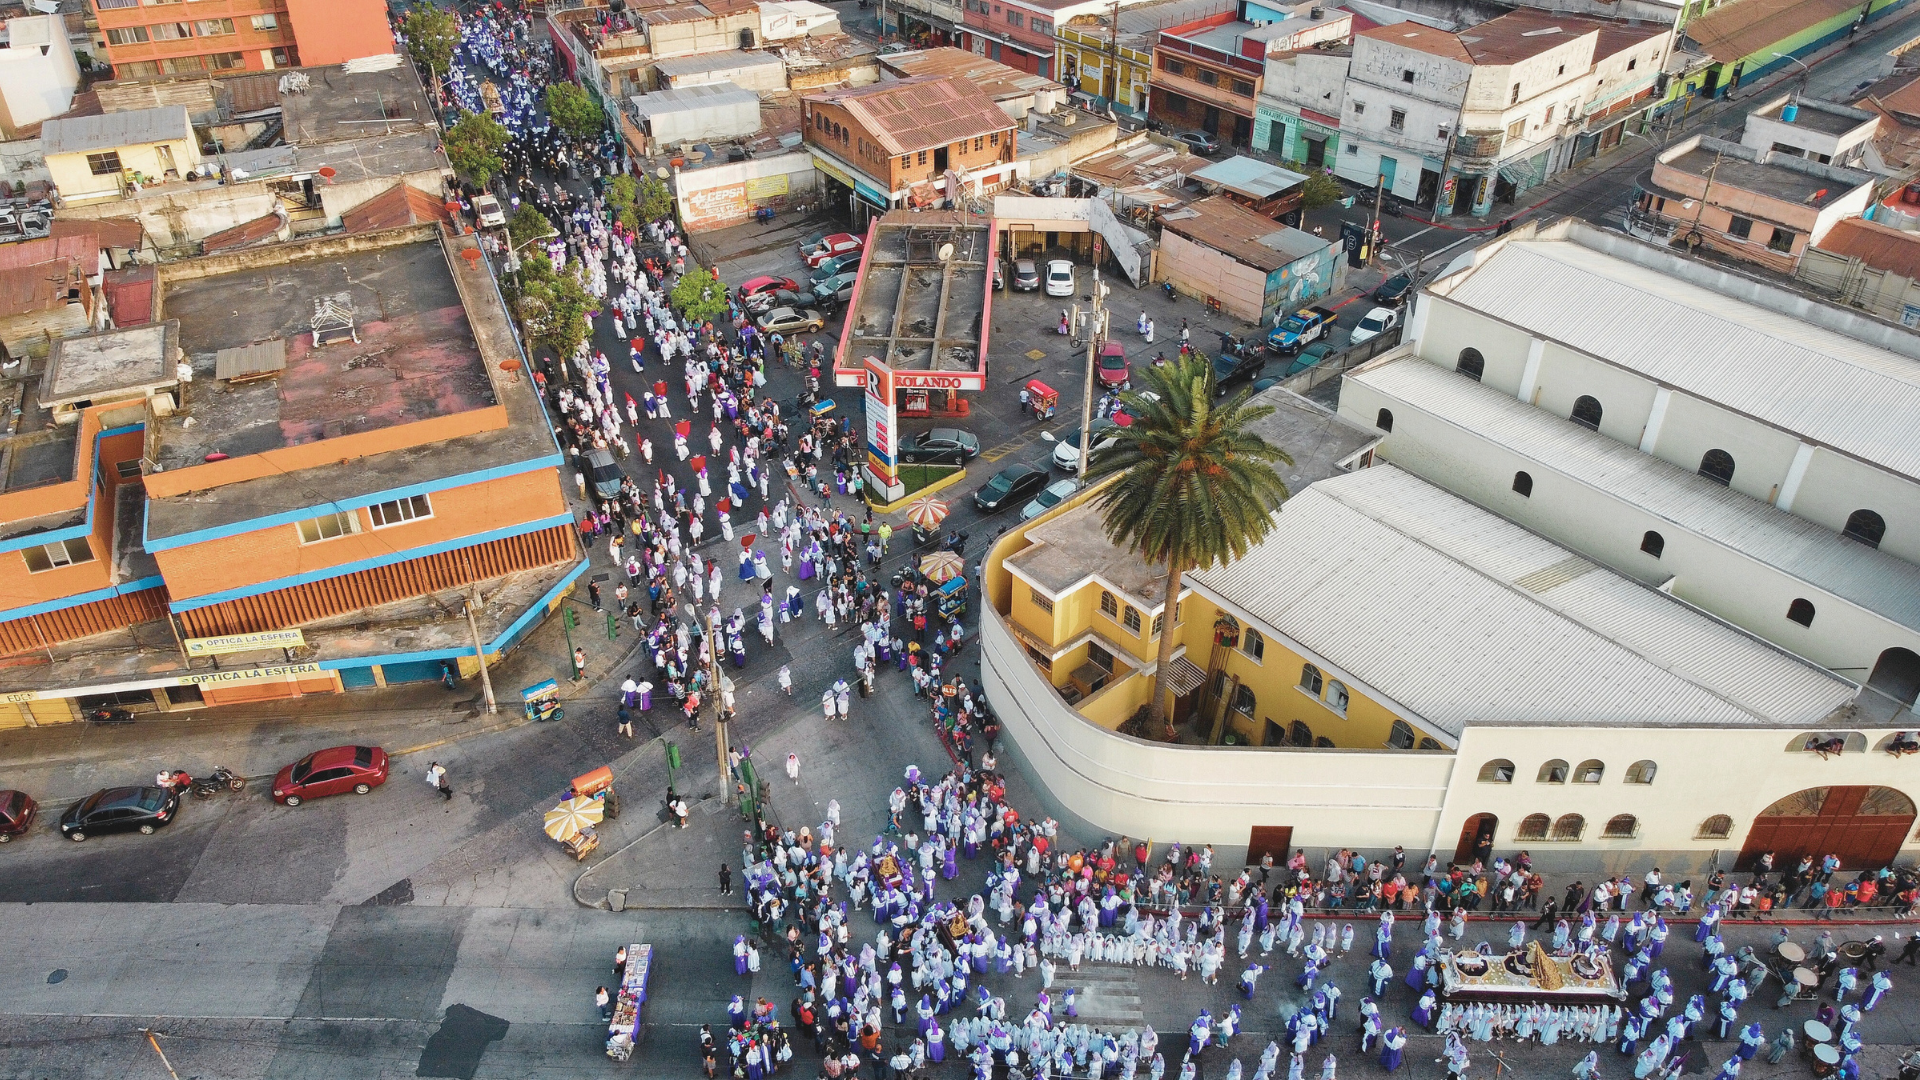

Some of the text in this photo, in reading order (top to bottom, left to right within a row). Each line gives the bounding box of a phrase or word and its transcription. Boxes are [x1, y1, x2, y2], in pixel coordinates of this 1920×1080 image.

[707, 187, 745, 202] CEPSA
[866, 368, 884, 400] R
[896, 376, 962, 388] ROLANDO
[206, 637, 244, 646] OPTICA
[261, 632, 299, 641] ESFERA
[192, 664, 316, 684] OPTICA LA ESFERA
